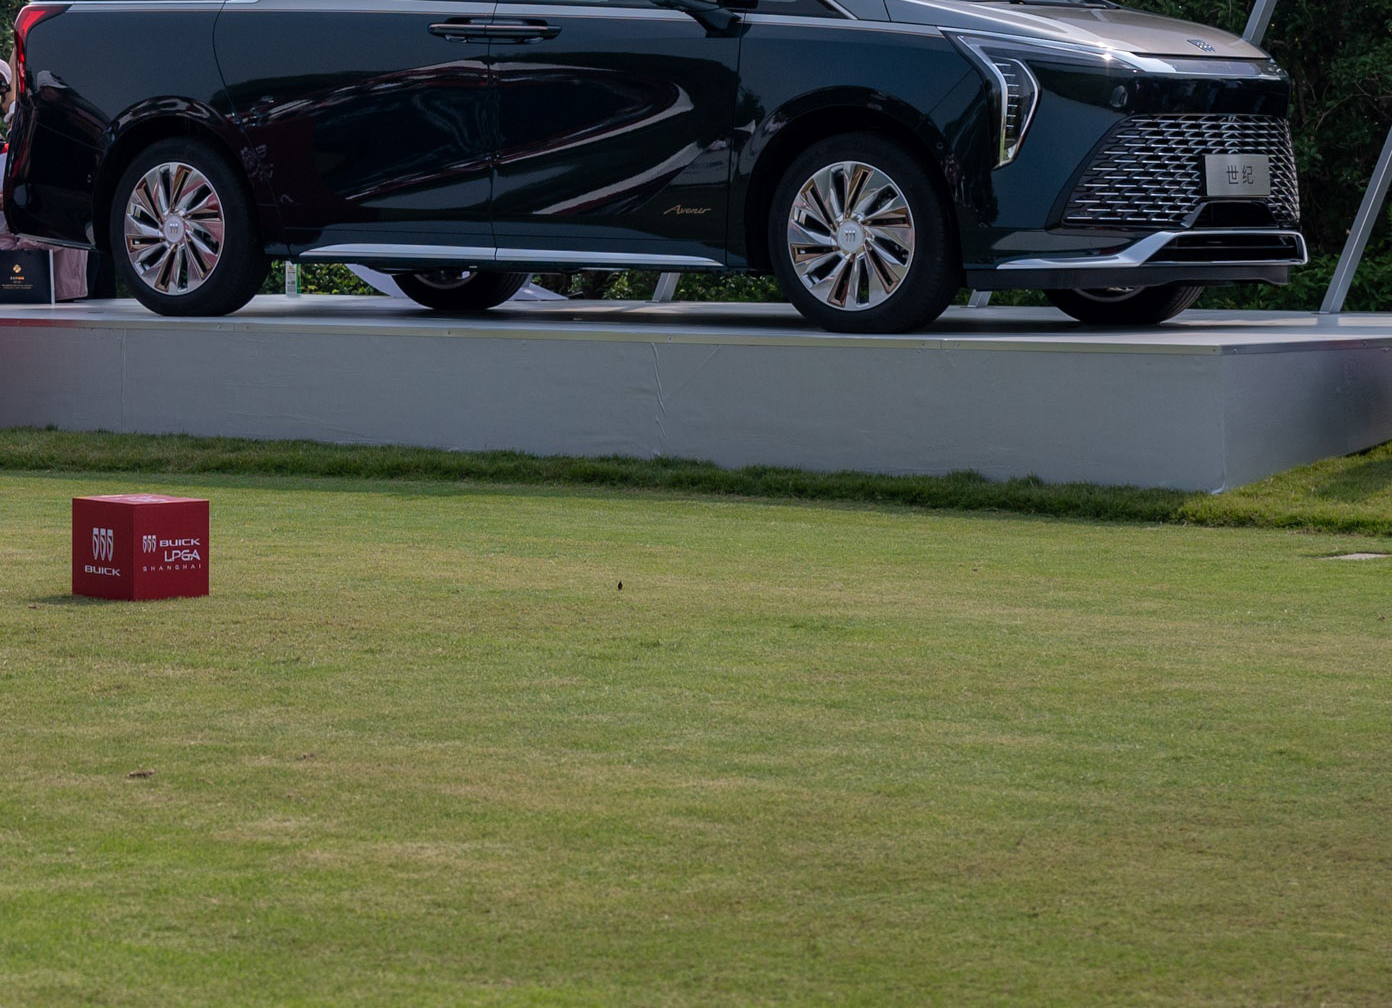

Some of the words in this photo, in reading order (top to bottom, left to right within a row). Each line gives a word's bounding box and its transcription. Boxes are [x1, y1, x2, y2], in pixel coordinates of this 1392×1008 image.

[1226, 164, 1255, 185] 世纪
[159, 538, 201, 548] BUICK
[164, 549, 201, 562] LPGA
[84, 564, 121, 577] BUICK
[142, 564, 202, 572] SHANGHAI
